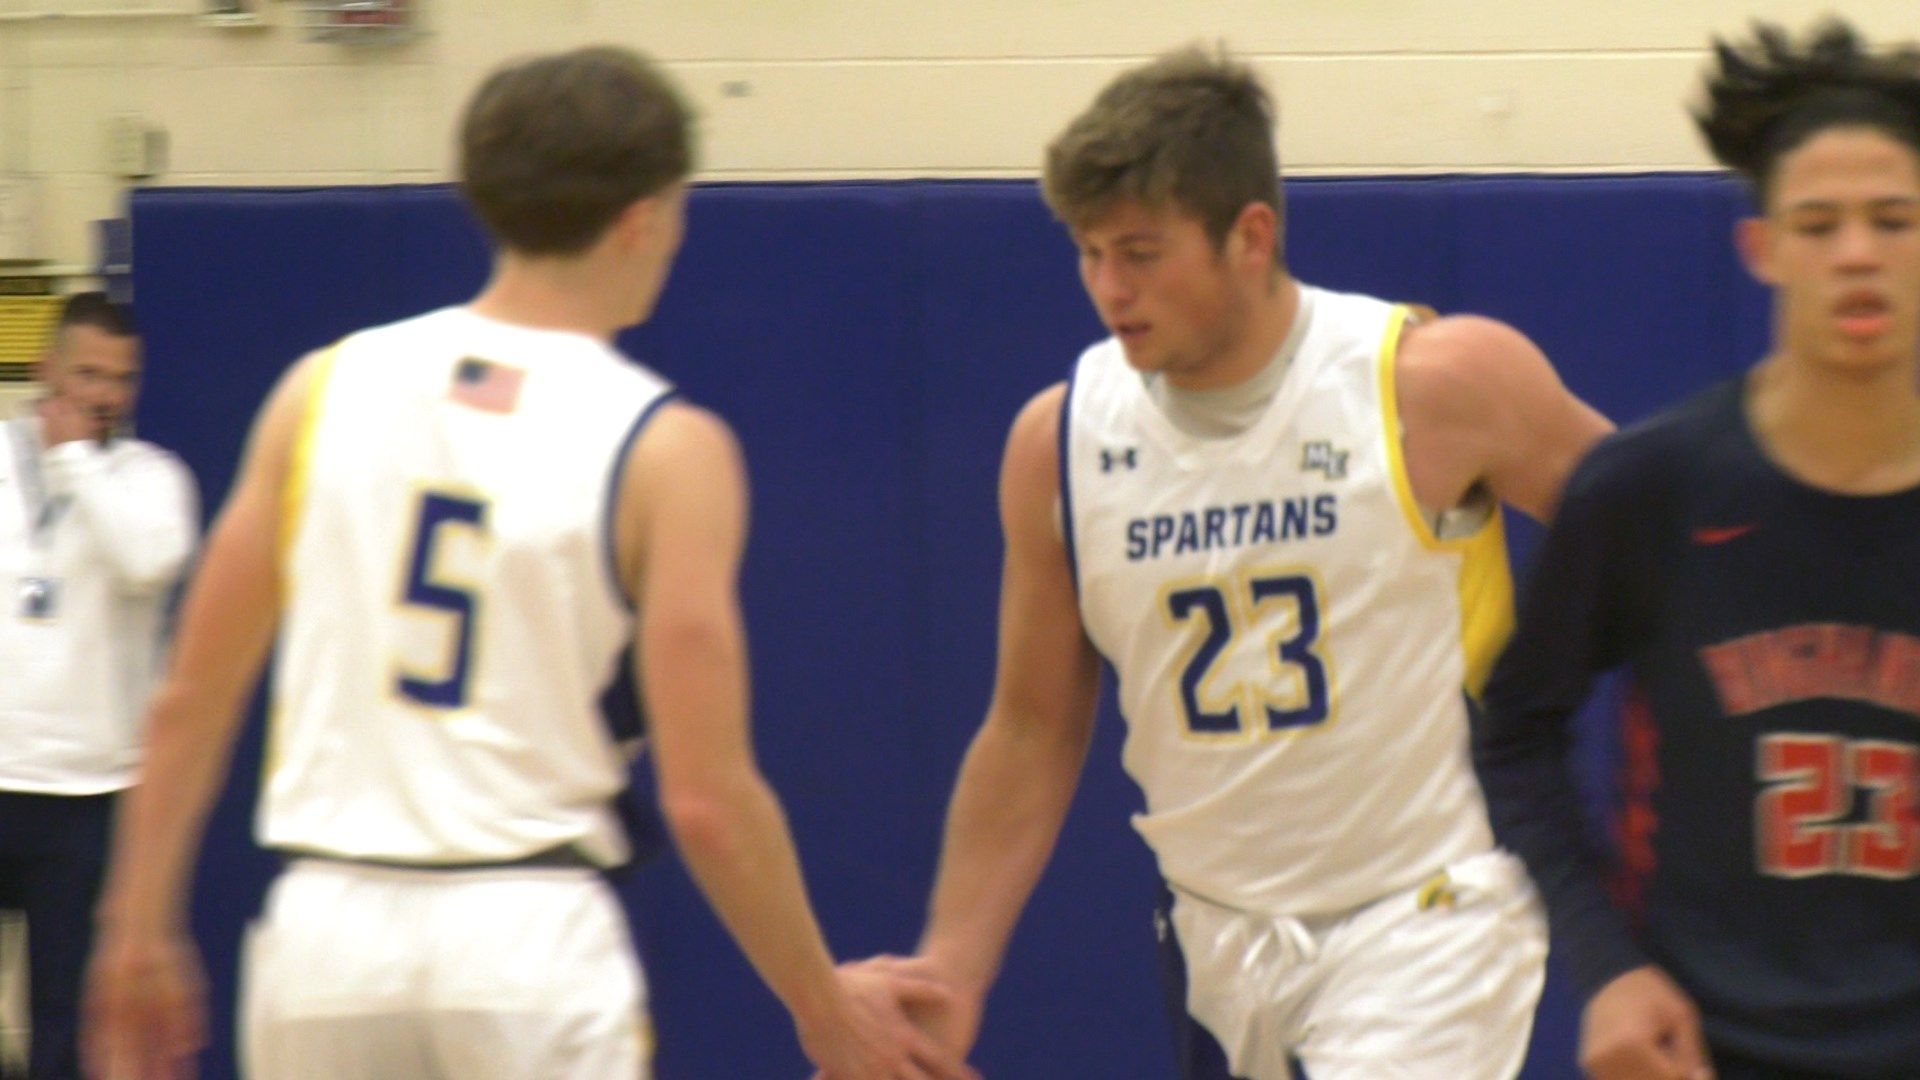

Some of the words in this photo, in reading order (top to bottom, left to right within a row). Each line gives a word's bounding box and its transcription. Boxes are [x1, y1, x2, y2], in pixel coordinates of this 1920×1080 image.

[392, 486, 490, 713] 5
[1126, 494, 1338, 562] SPARTANS
[1160, 568, 1335, 740] 23
[1755, 732, 1920, 879] 23
